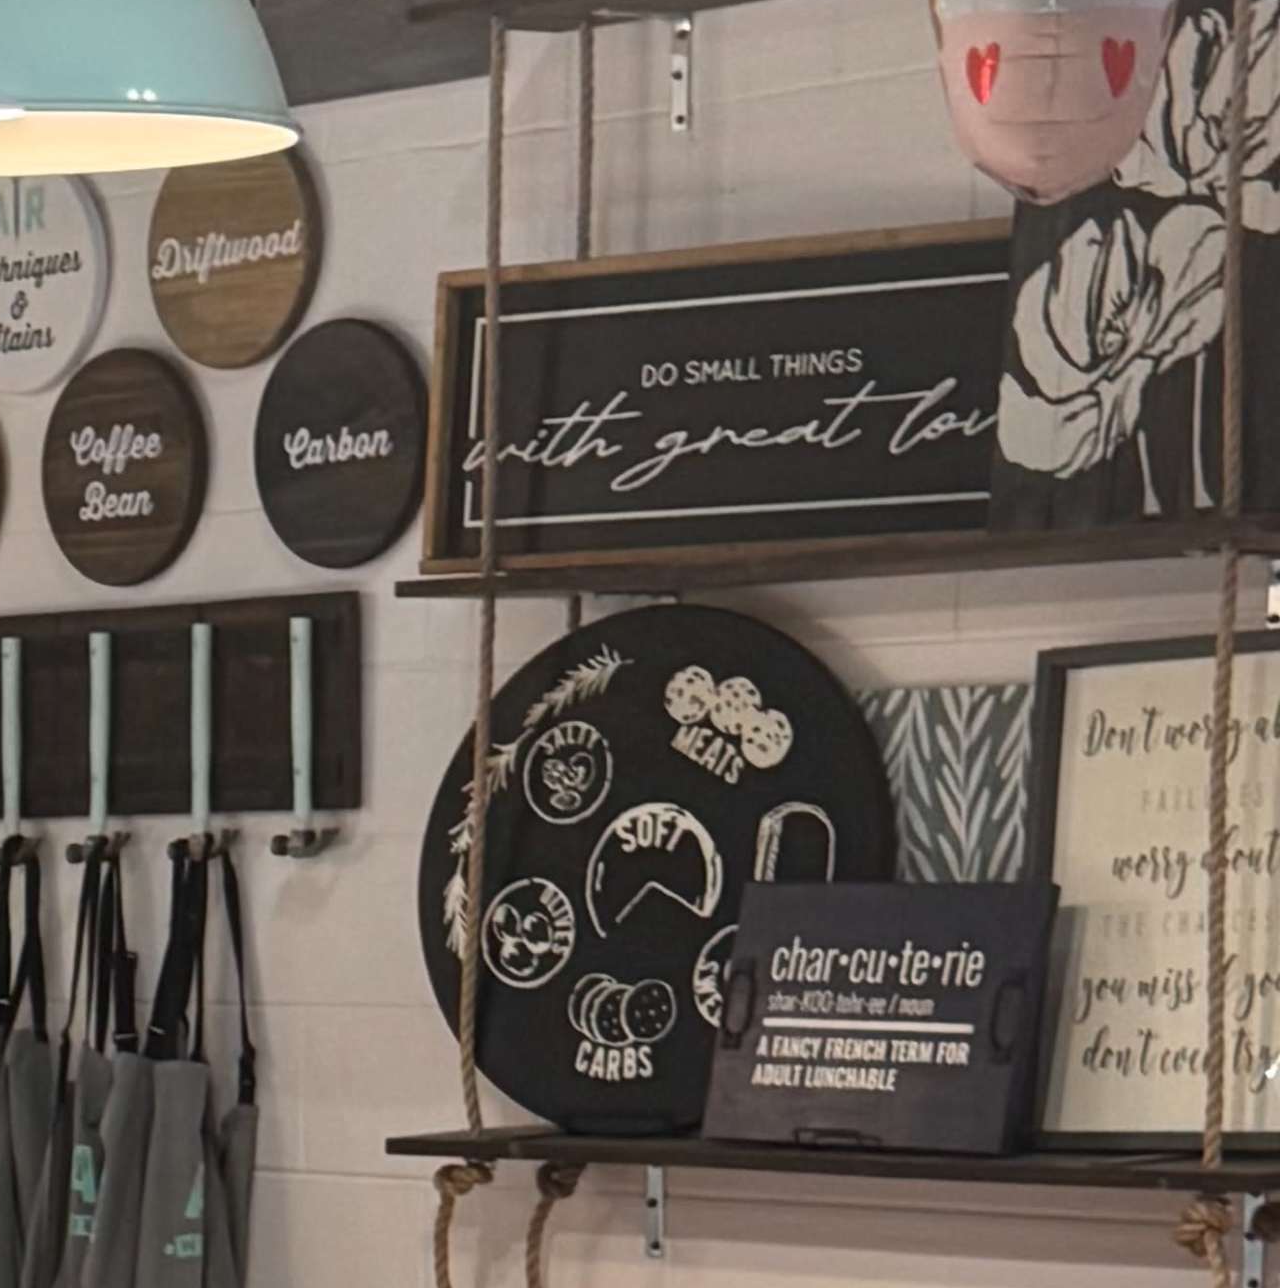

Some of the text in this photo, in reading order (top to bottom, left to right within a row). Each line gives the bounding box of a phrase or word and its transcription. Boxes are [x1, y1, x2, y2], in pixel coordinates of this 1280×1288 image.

[151, 218, 303, 286] Driftwood
[10, 290, 28, 320] &
[640, 347, 864, 389] DO SMALL THINGS
[70, 425, 162, 474] Coffee
[284, 426, 393, 469] Carbon
[463, 377, 999, 492] with great lov
[78, 481, 154, 523] Bean
[541, 724, 600, 755] SALTY
[670, 724, 744, 784] MEATS
[1164, 713, 1241, 765] wory
[615, 814, 687, 853] SOFT
[1112, 845, 1190, 900] worry
[539, 884, 572, 955] OLIVES
[1074, 976, 1126, 1025] you
[1138, 967, 1196, 1012] miss
[575, 1039, 654, 1081] CARBS
[756, 1035, 970, 1065] A FANCY FRENCH TERM FOR
[1081, 1024, 1159, 1078] don't
[751, 1063, 898, 1092] ADULT LUNCHABLE
